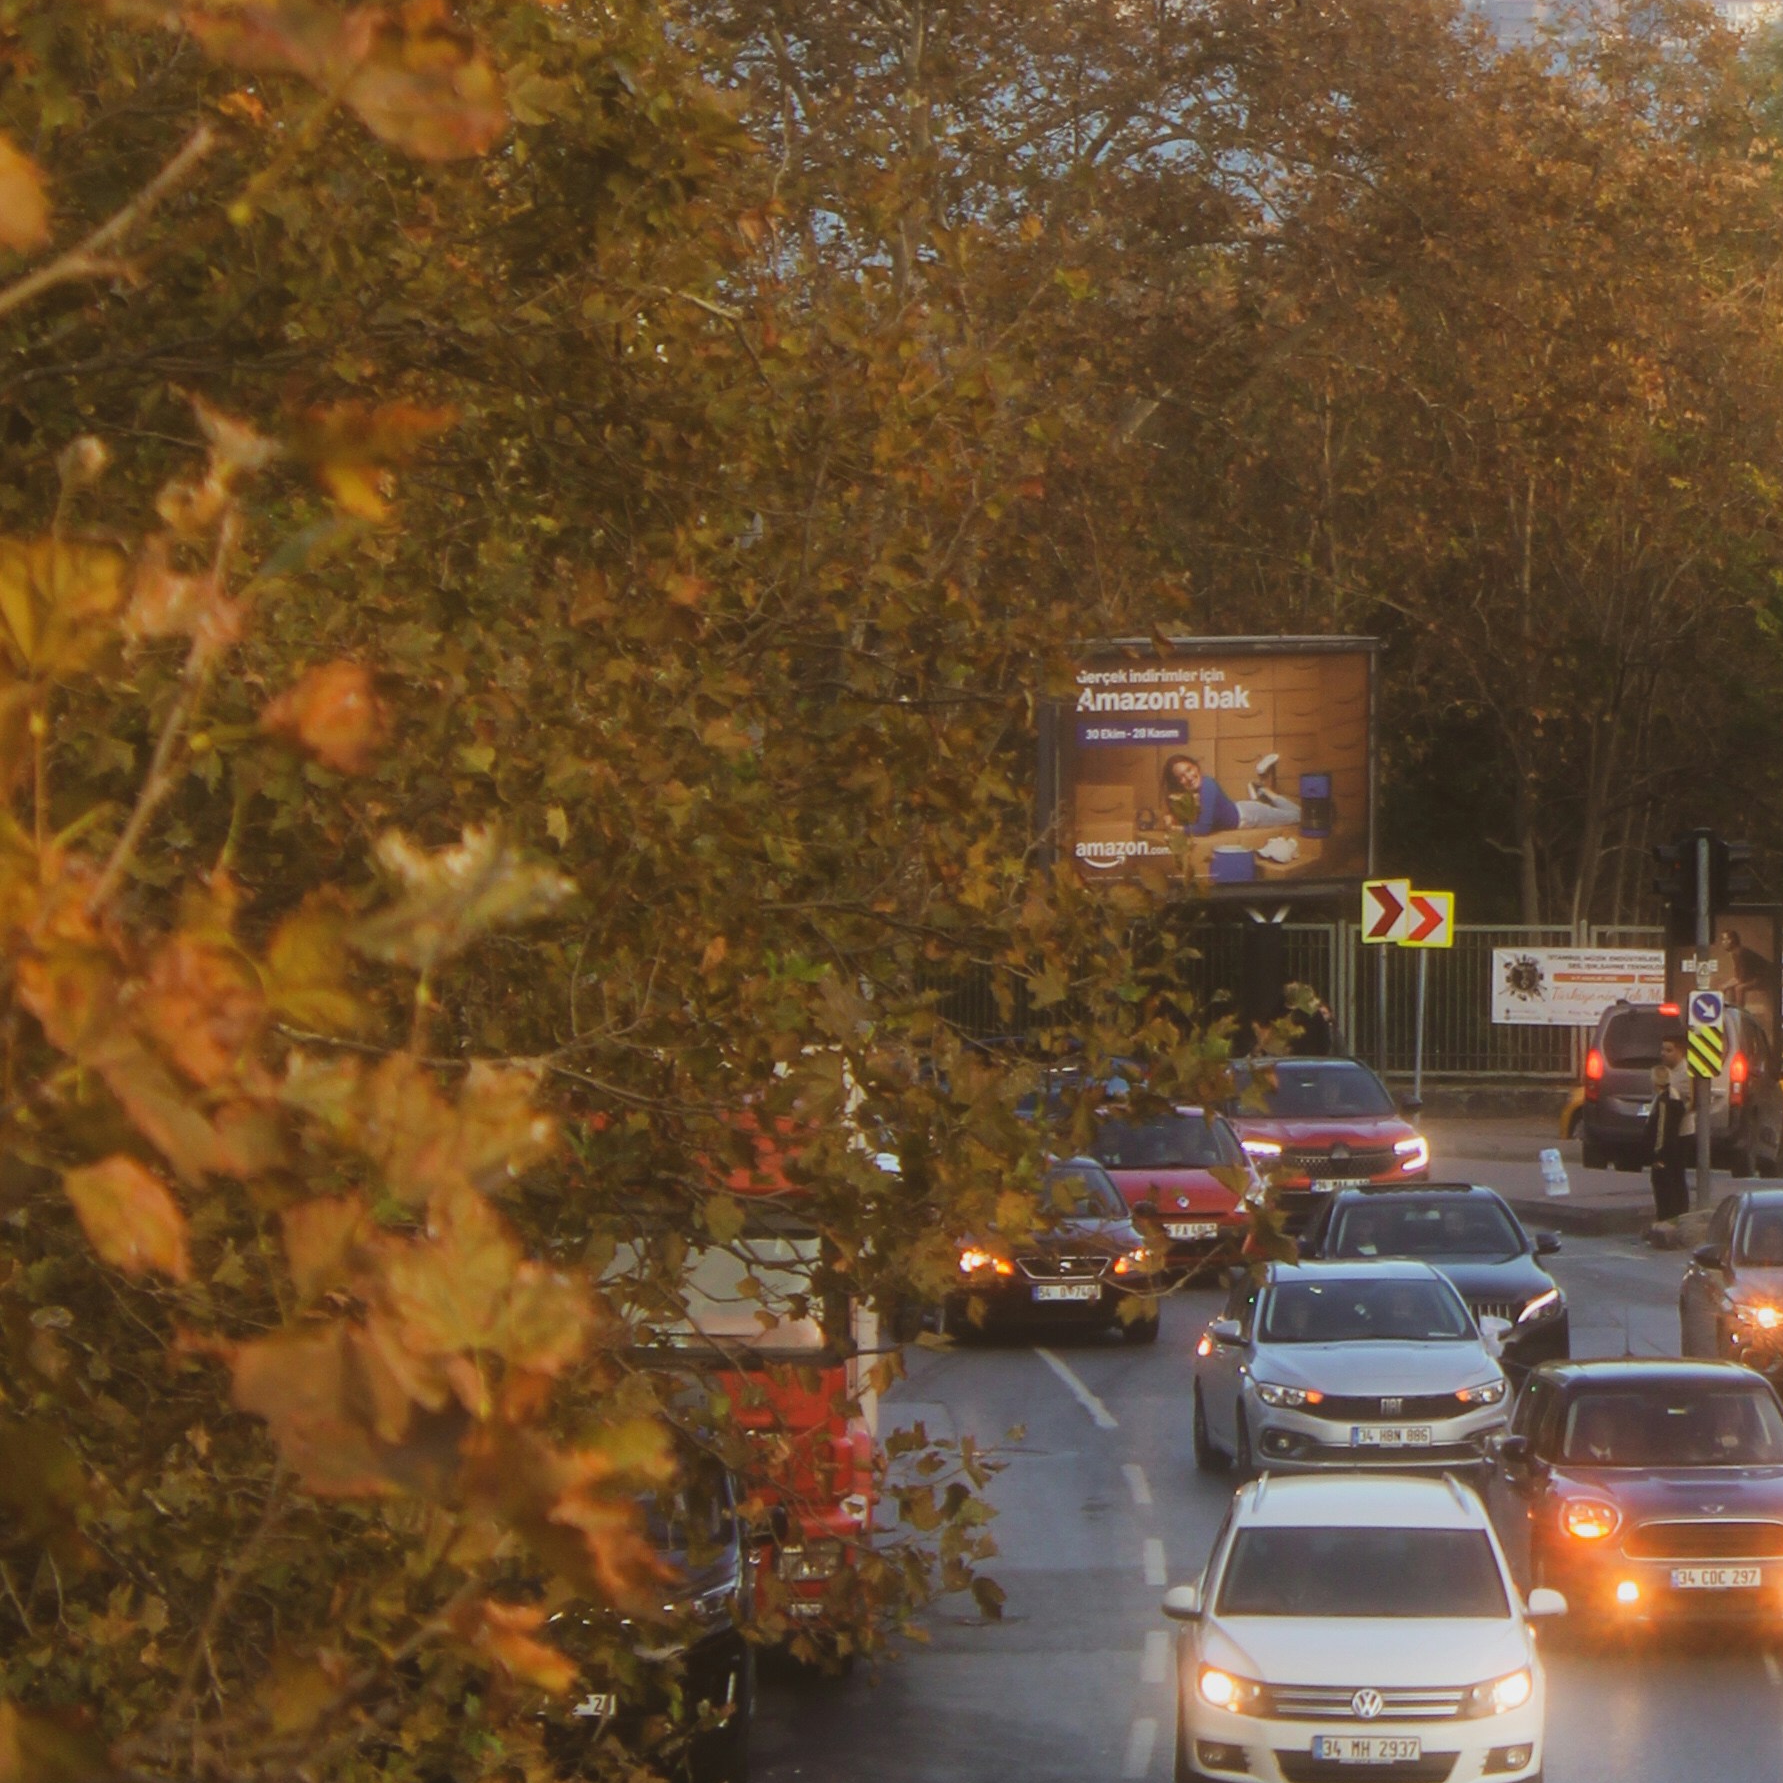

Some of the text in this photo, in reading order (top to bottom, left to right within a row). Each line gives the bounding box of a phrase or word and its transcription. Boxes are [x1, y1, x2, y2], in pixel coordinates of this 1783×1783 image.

[1129, 669, 1198, 683] indirimler
[1200, 668, 1225, 683] için
[1076, 685, 1250, 712] Amazon'a bak
[1086, 729, 1099, 740] 30
[1101, 729, 1126, 740] Ekim
[1148, 728, 1179, 738] Kasım
[1359, 1429, 1373, 1442] 34
[1679, 1570, 1695, 1585] 34
[1732, 1569, 1757, 1584] 297
[1323, 1740, 1417, 1757] 34 MH 2937
